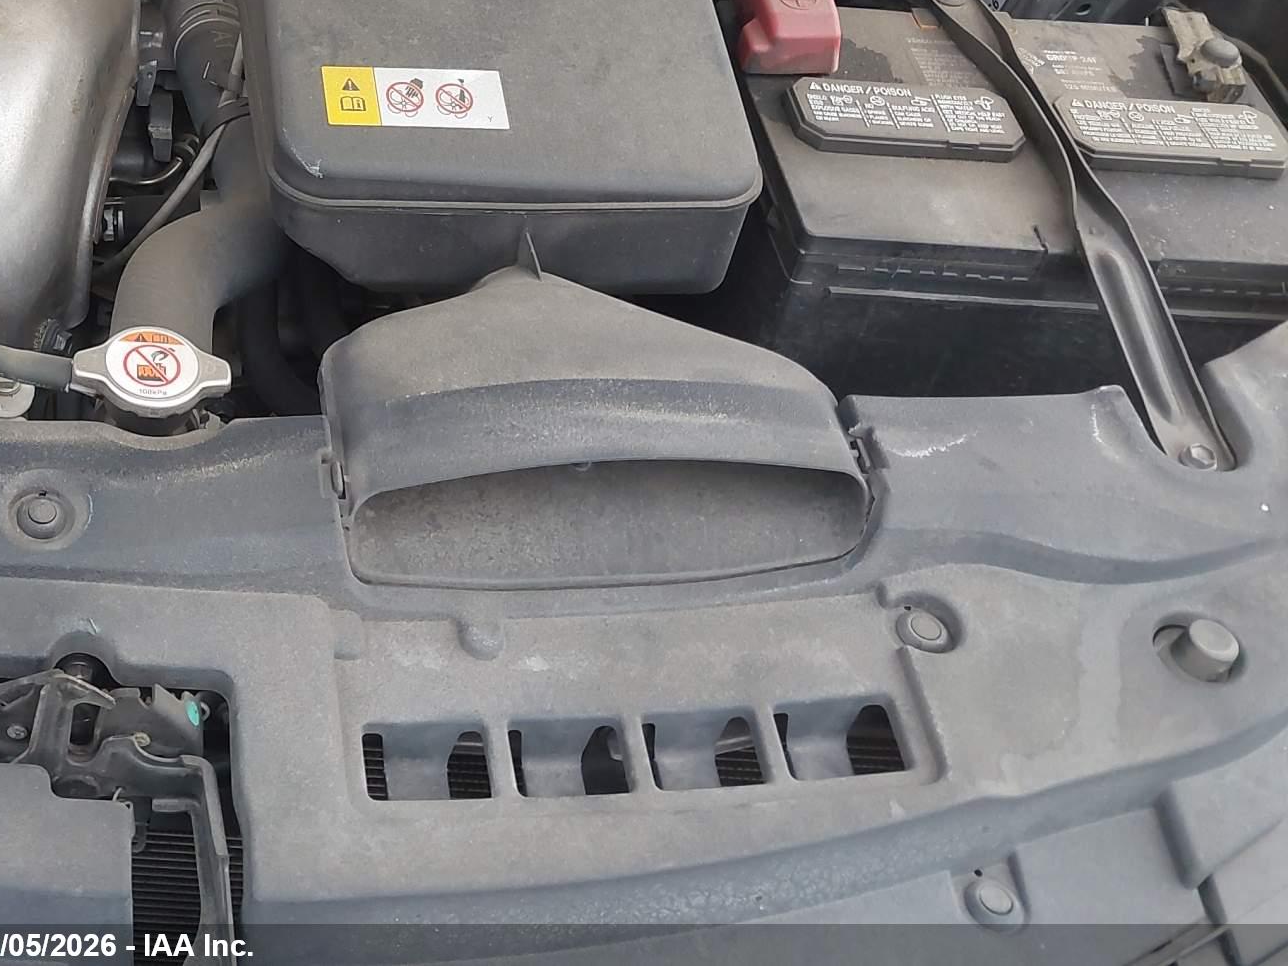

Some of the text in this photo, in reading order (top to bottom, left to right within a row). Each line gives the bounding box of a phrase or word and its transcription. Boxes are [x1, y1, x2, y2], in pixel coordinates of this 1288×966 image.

[822, 83, 864, 94] DANGER
[873, 87, 912, 97] POISON
[1084, 100, 1128, 111] DANGER
[1135, 103, 1176, 114] POISON
